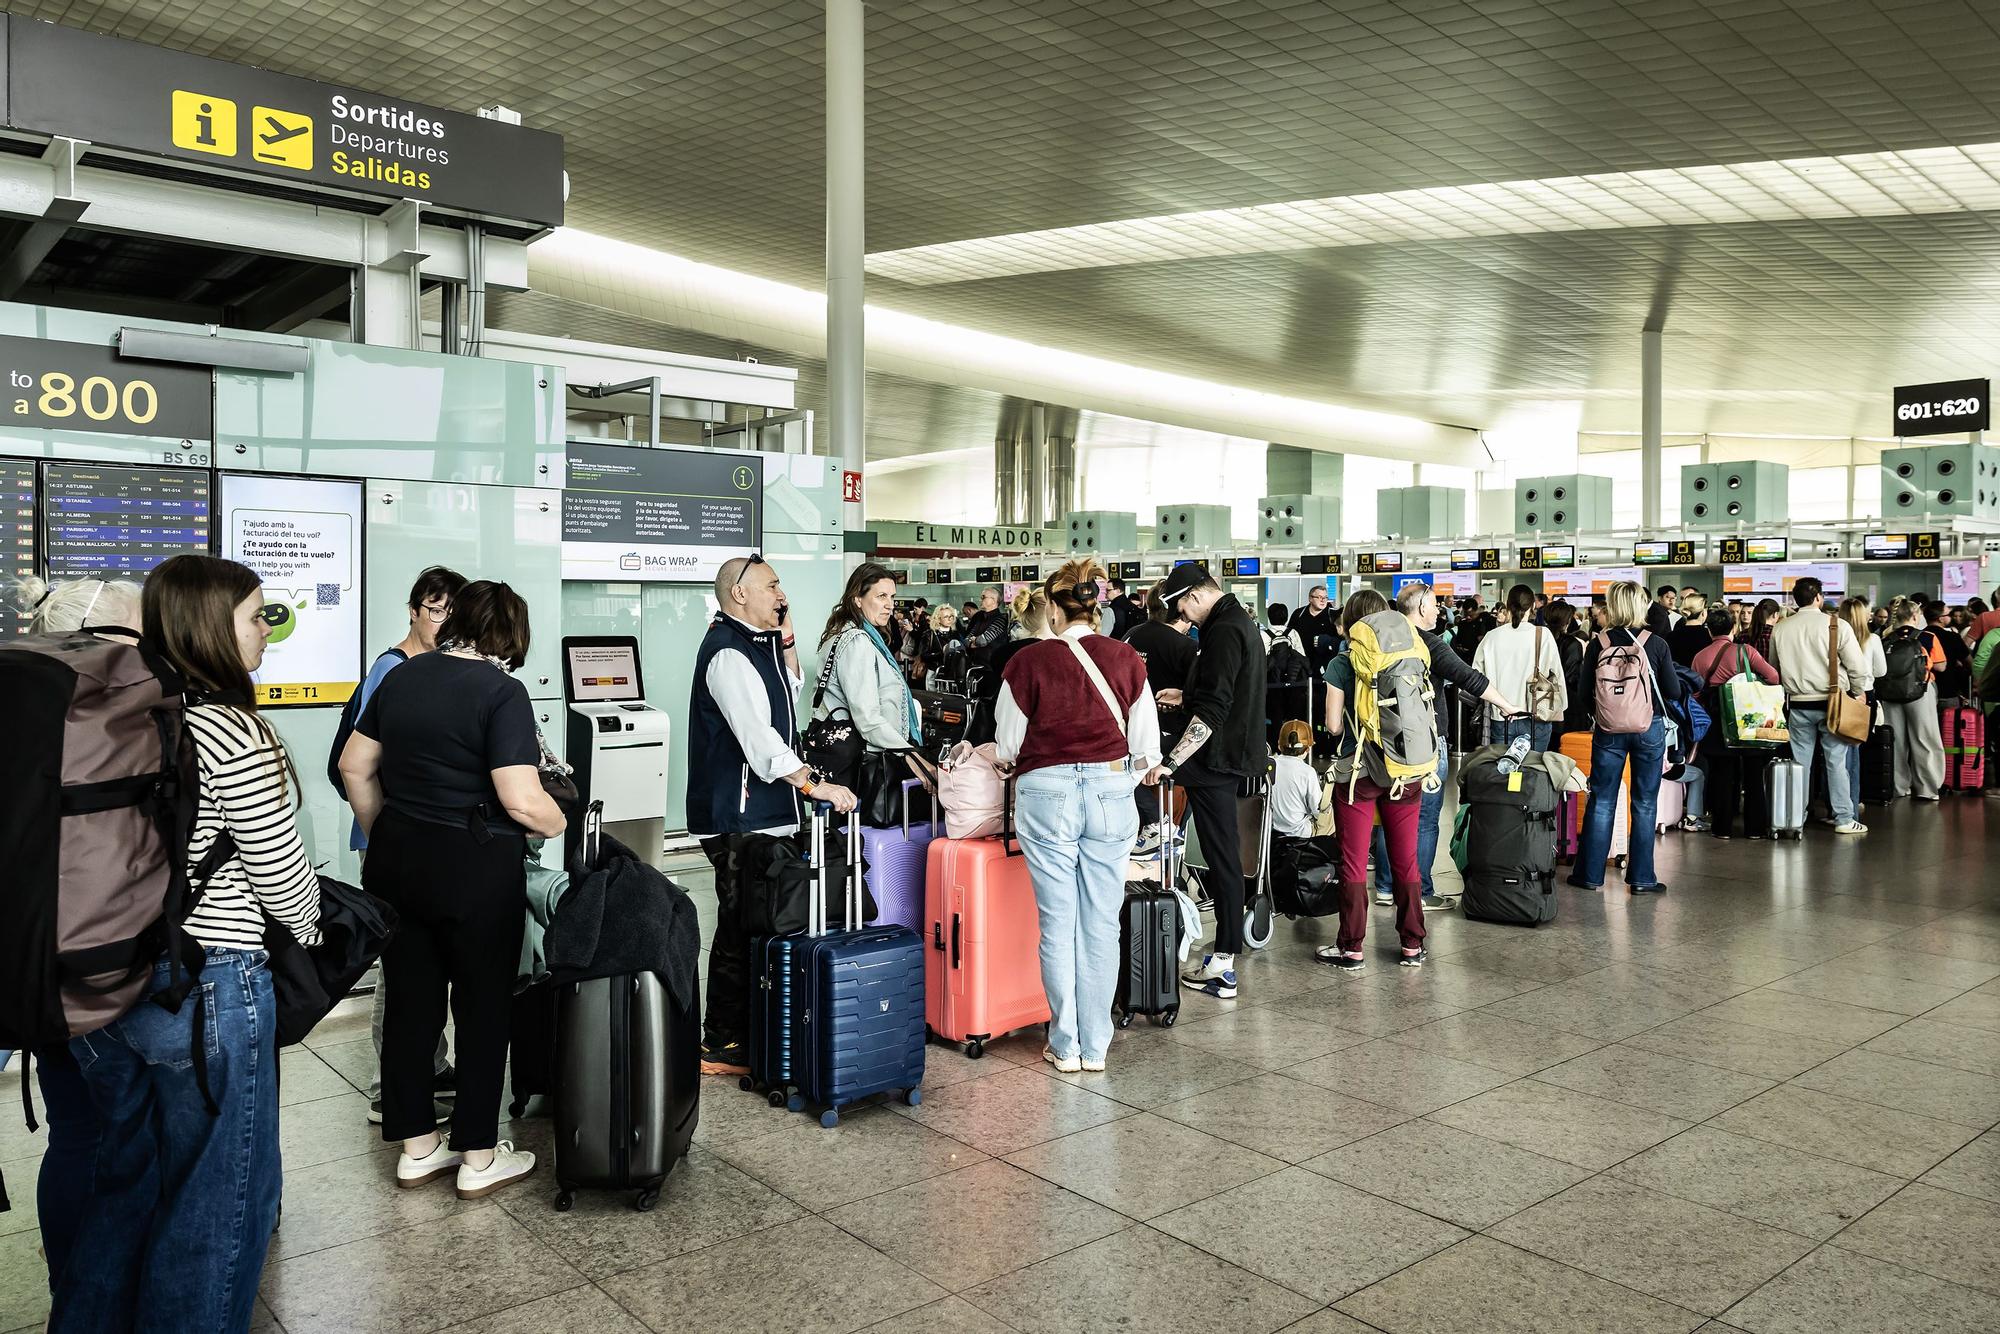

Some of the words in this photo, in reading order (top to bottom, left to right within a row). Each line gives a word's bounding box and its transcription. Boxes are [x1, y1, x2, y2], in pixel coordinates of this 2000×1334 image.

[332, 95, 445, 138] Sortides
[331, 124, 448, 165] Departures
[332, 151, 431, 189] Salidas
[10, 370, 33, 388] to
[38, 372, 158, 424] 800
[14, 398, 29, 414] a
[163, 452, 183, 464] BS
[189, 453, 208, 465] 69
[243, 520, 269, 528] T'ajudo
[916, 526, 937, 543] EL
[951, 528, 1042, 546] MIRADOR
[258, 541, 282, 549] ayudo
[1915, 549, 1935, 557] 601
[644, 556, 667, 566] BAG
[668, 557, 698, 566] WRAP
[1521, 559, 1537, 568] 604
[1674, 555, 1692, 563] 603
[1483, 561, 1498, 569] 605
[302, 687, 318, 697] T1
